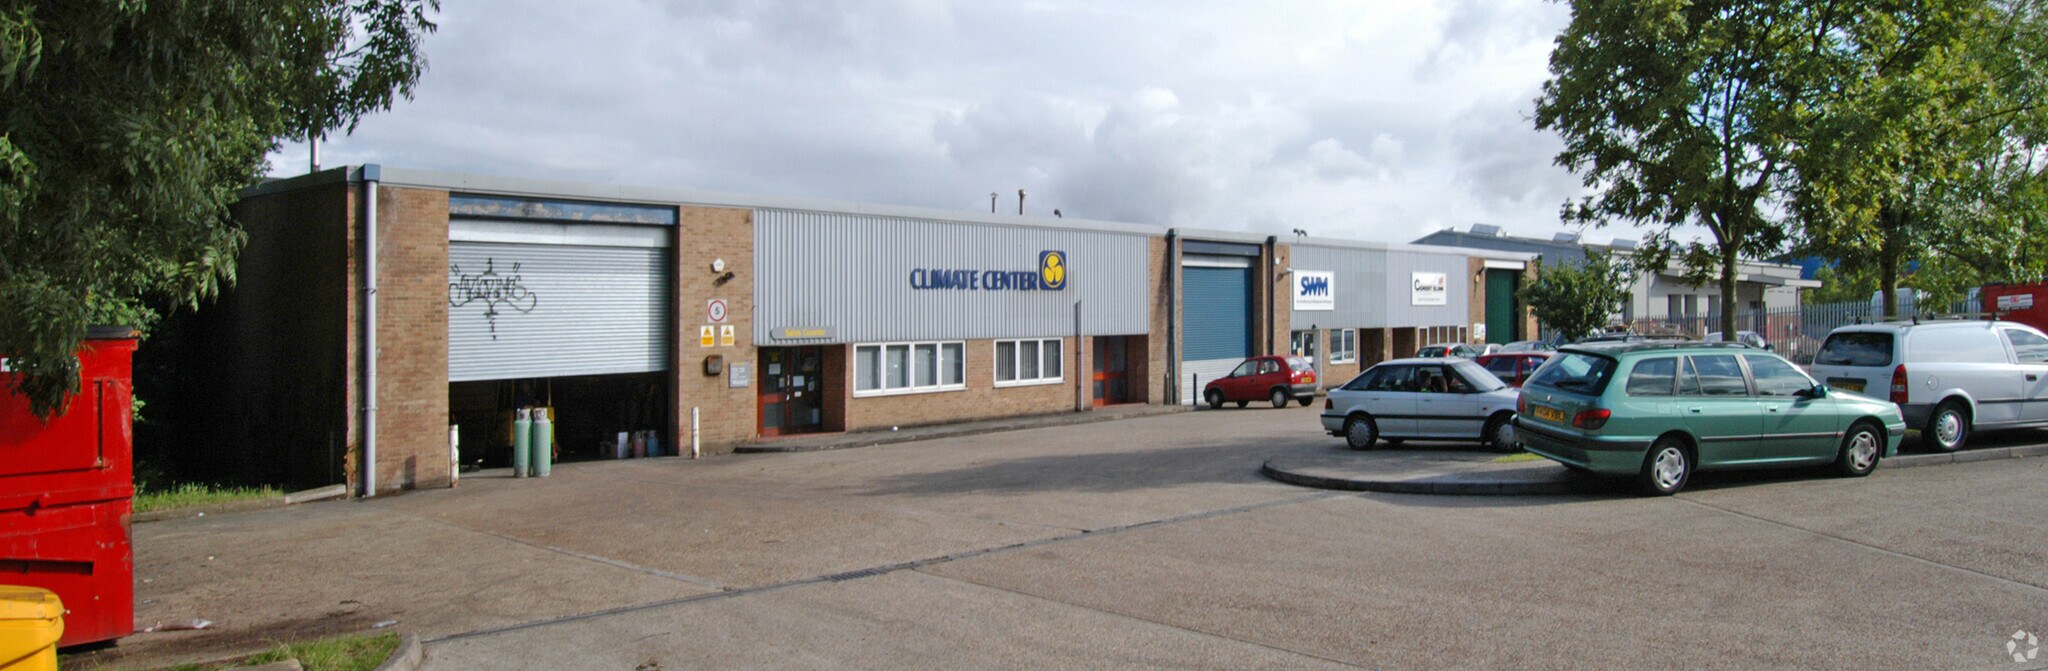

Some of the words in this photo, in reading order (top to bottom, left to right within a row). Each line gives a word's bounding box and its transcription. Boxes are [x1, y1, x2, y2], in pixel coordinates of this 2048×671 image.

[910, 268, 979, 290] CLIMATE
[982, 270, 1038, 291] CENTER
[1300, 276, 1328, 296] SWM
[714, 306, 720, 316] 5
